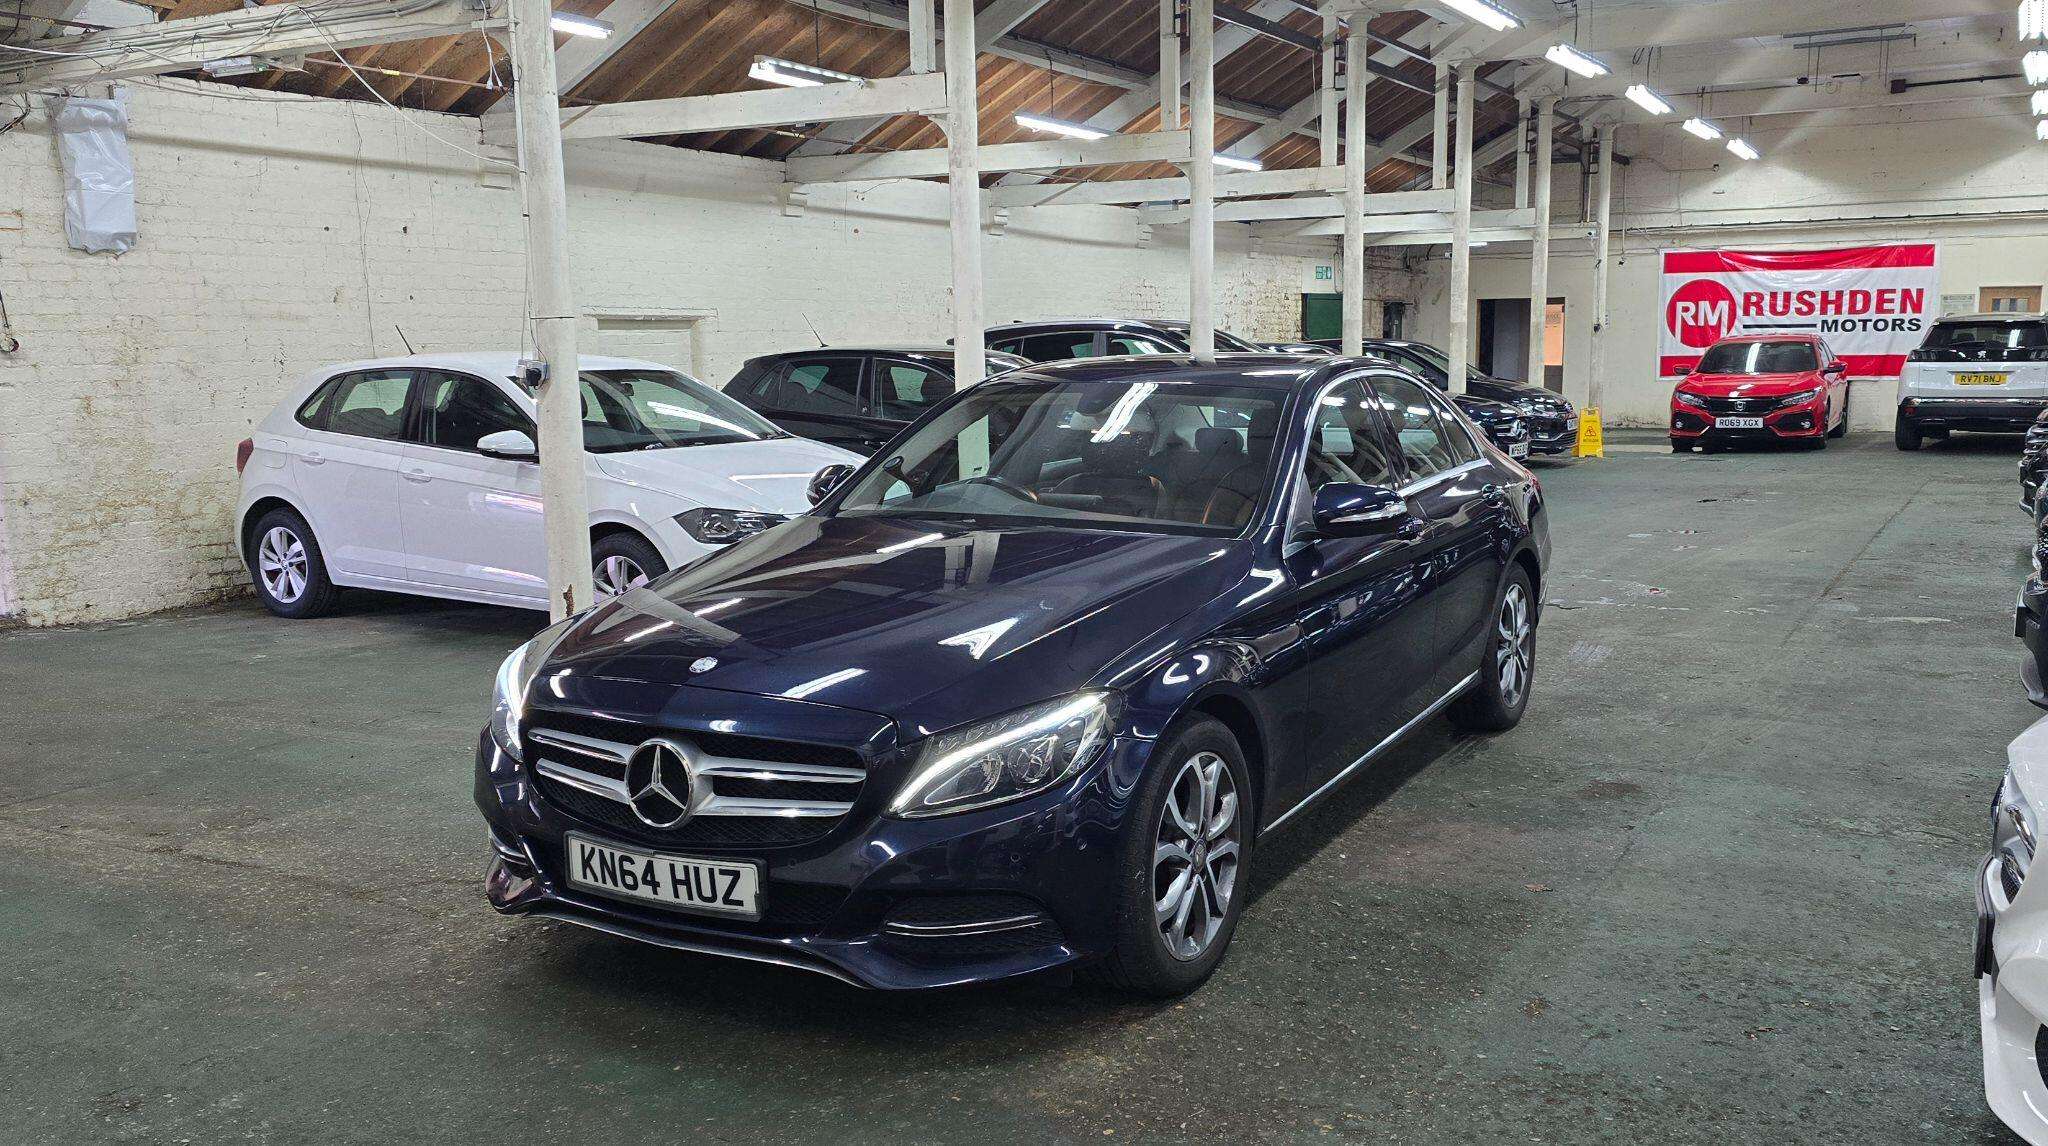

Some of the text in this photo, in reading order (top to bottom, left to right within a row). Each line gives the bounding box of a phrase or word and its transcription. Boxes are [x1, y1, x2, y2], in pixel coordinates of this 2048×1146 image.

[1742, 288, 1924, 316] RUSHDEN
[1674, 300, 1730, 338] RM
[1820, 318, 1922, 333] MOTORS
[1983, 375, 2002, 383] BNJ
[1719, 419, 1759, 427] RO69 XGX
[579, 843, 744, 907] KN64 HUZ
